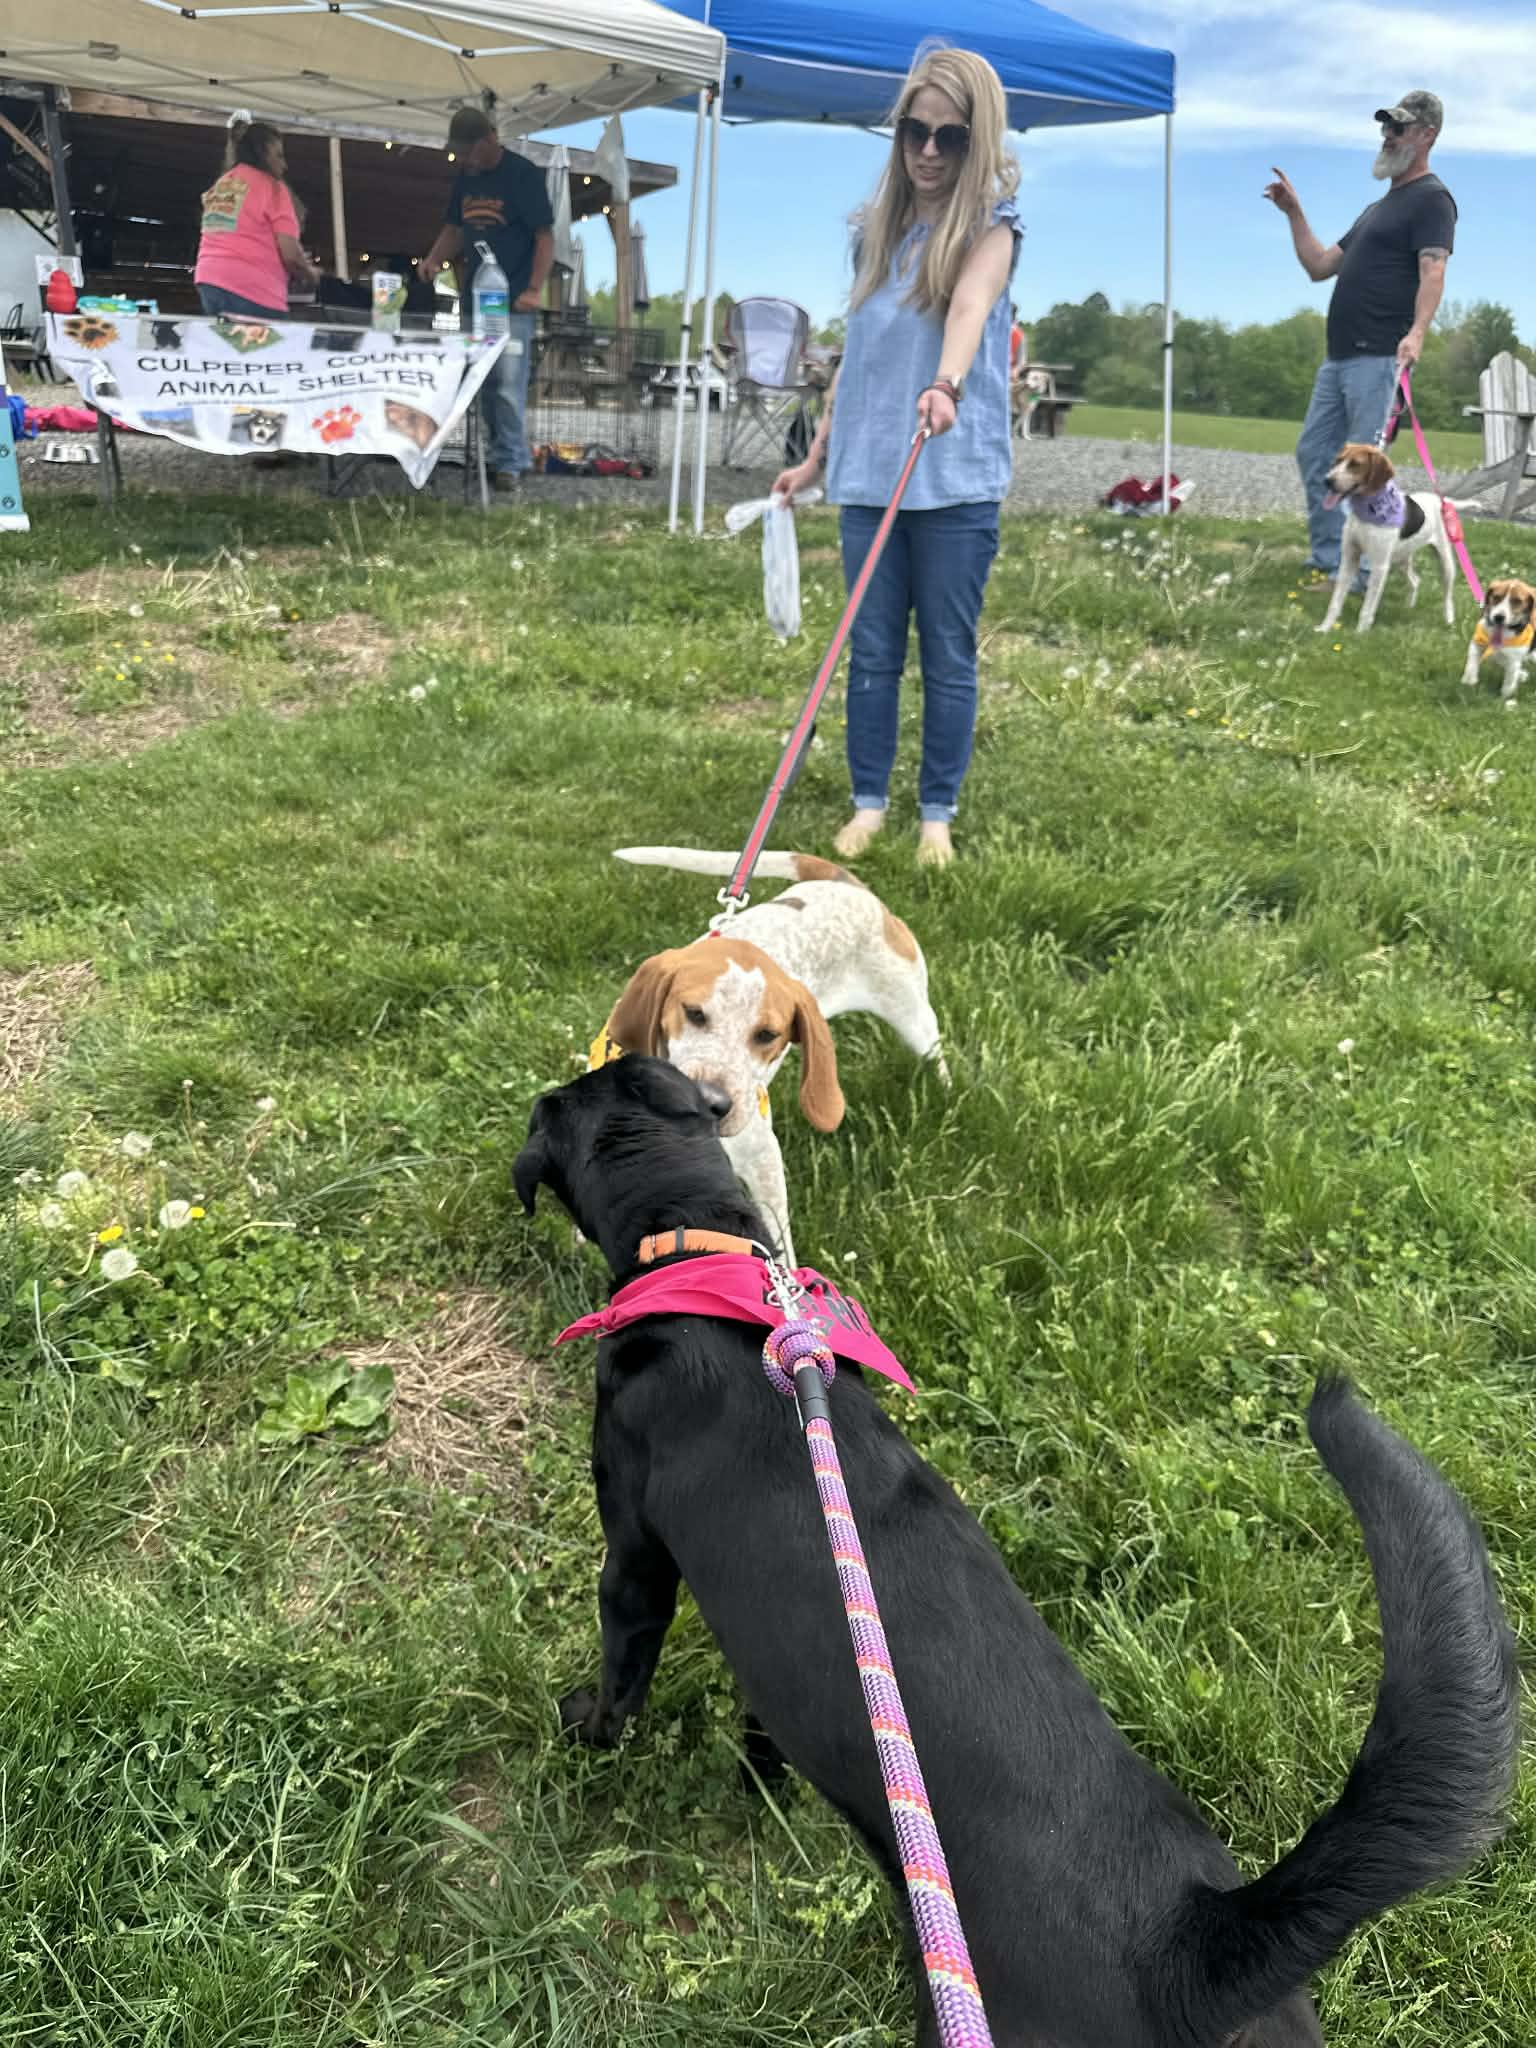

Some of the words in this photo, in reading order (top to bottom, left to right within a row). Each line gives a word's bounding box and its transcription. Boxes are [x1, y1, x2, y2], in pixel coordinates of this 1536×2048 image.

[137, 356, 304, 375] CULPEPER
[328, 352, 447, 368] COUNTY
[157, 380, 278, 397] ANIMAL
[298, 369, 438, 392] SHELTER
